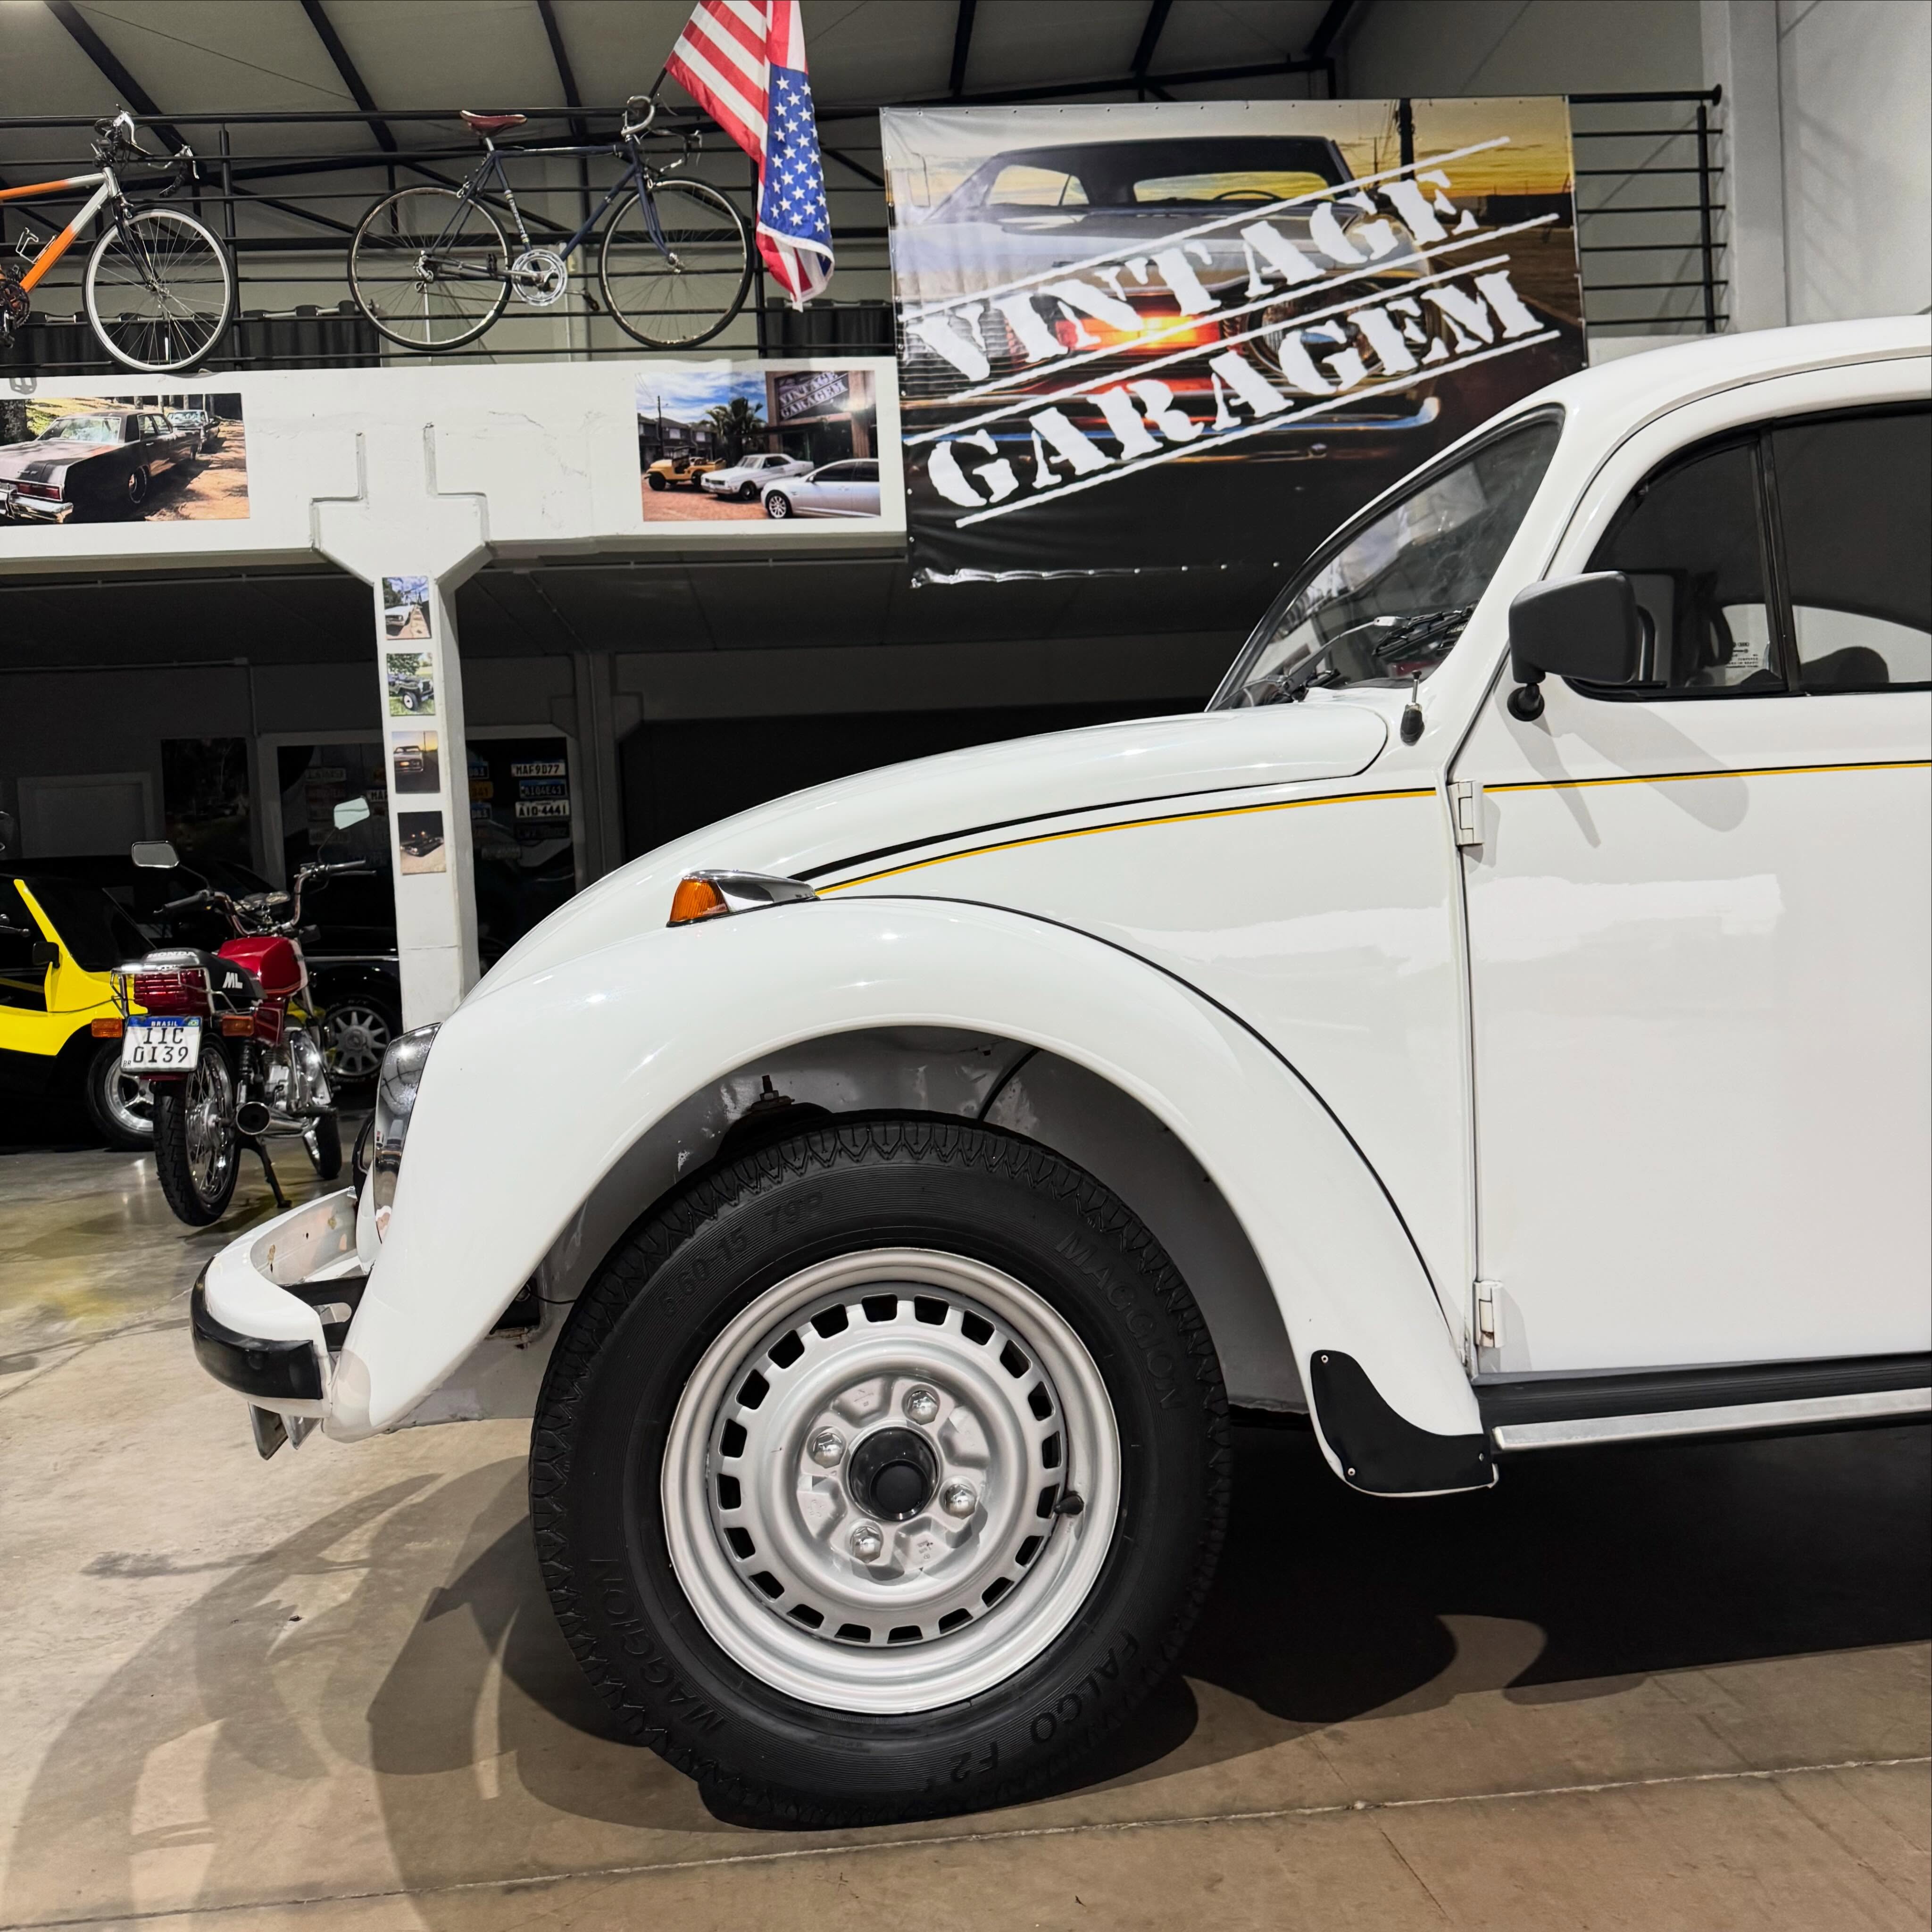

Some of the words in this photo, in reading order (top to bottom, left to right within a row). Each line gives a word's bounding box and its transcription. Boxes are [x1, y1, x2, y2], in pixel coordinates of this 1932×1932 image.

[906, 168, 1478, 381] VINTAGE
[780, 372, 838, 404] VINTAGE
[781, 379, 846, 418] GARAGEM
[927, 271, 1544, 507] GARAGEM
[222, 972, 243, 989] ML
[133, 1046, 189, 1063] 0139
[143, 1027, 184, 1044] IIC
[1055, 1230, 1184, 1409] MAGGION
[589, 1559, 725, 1732] MAGGION
[1030, 1626, 1139, 1744] FALCO
